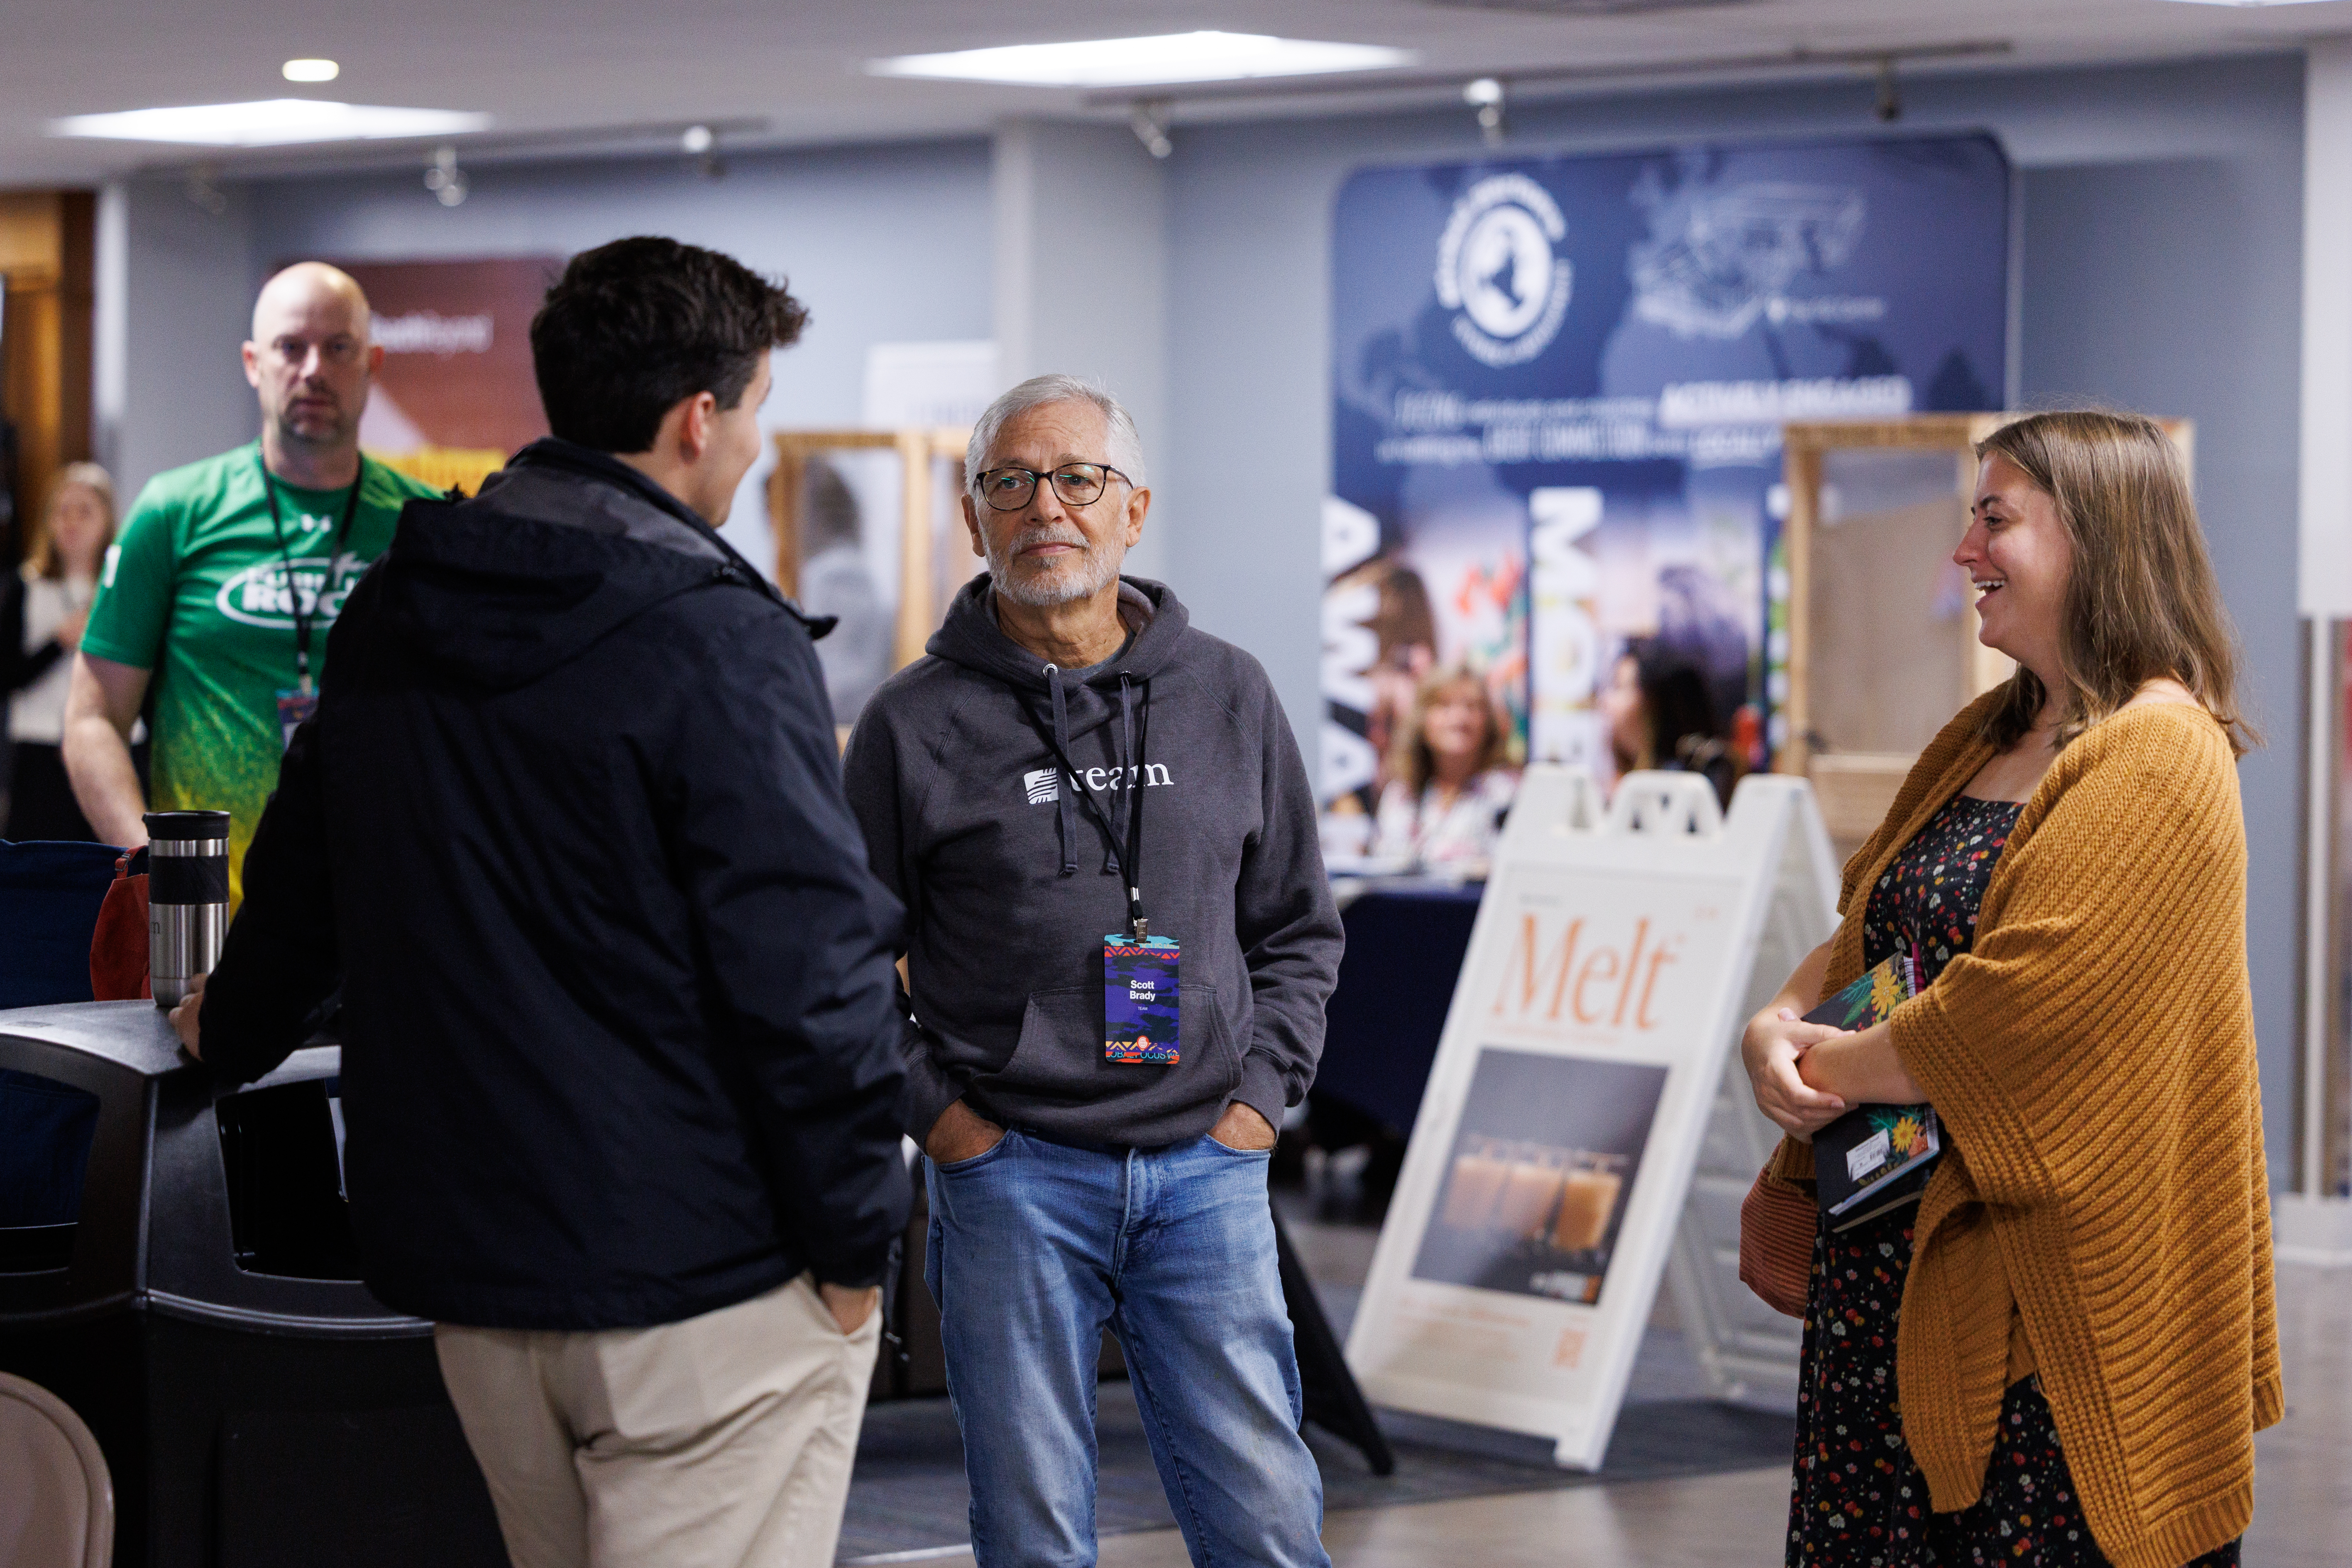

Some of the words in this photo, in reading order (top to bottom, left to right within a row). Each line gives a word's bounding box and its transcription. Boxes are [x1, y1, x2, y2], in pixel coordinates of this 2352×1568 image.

[1492, 911, 1679, 1030] Melt
[1130, 980, 1154, 989] Scott
[1130, 991, 1156, 1002] Brady
